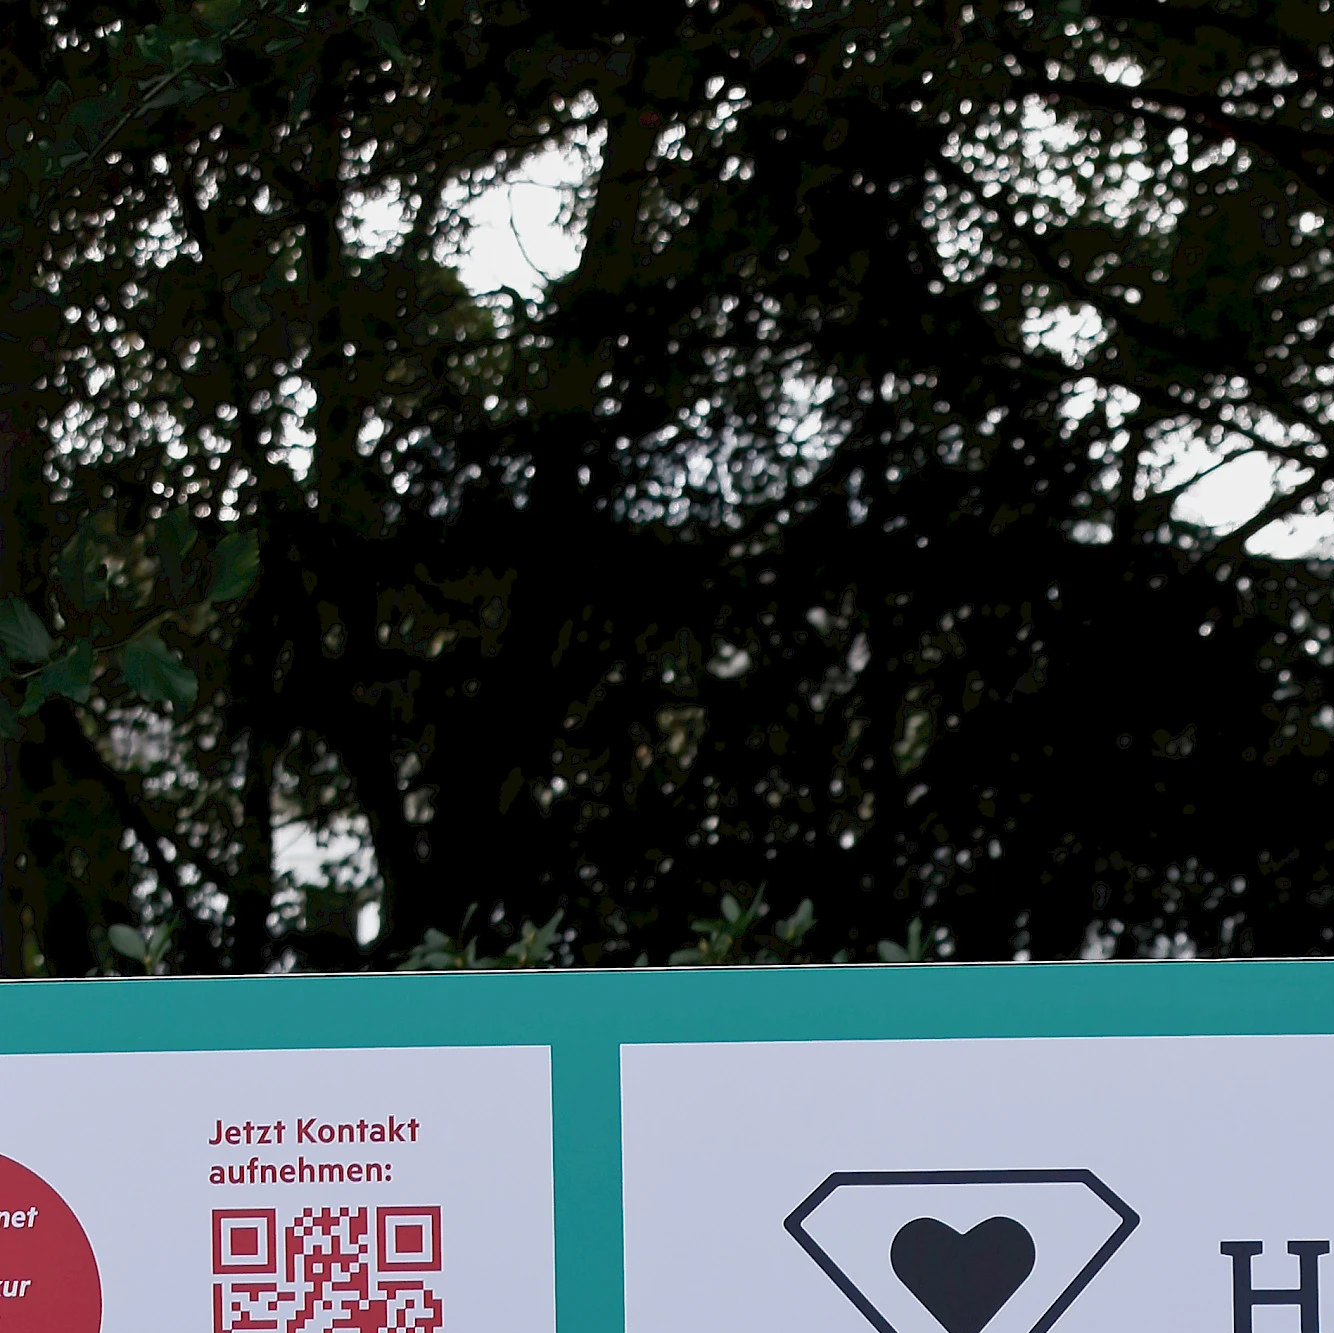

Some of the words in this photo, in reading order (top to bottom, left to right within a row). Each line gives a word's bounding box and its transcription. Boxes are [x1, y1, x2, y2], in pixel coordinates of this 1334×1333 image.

[208, 1119, 286, 1145] Jetzt
[297, 1115, 420, 1144] Kontakt
[208, 1156, 392, 1184] aufnehmen:
